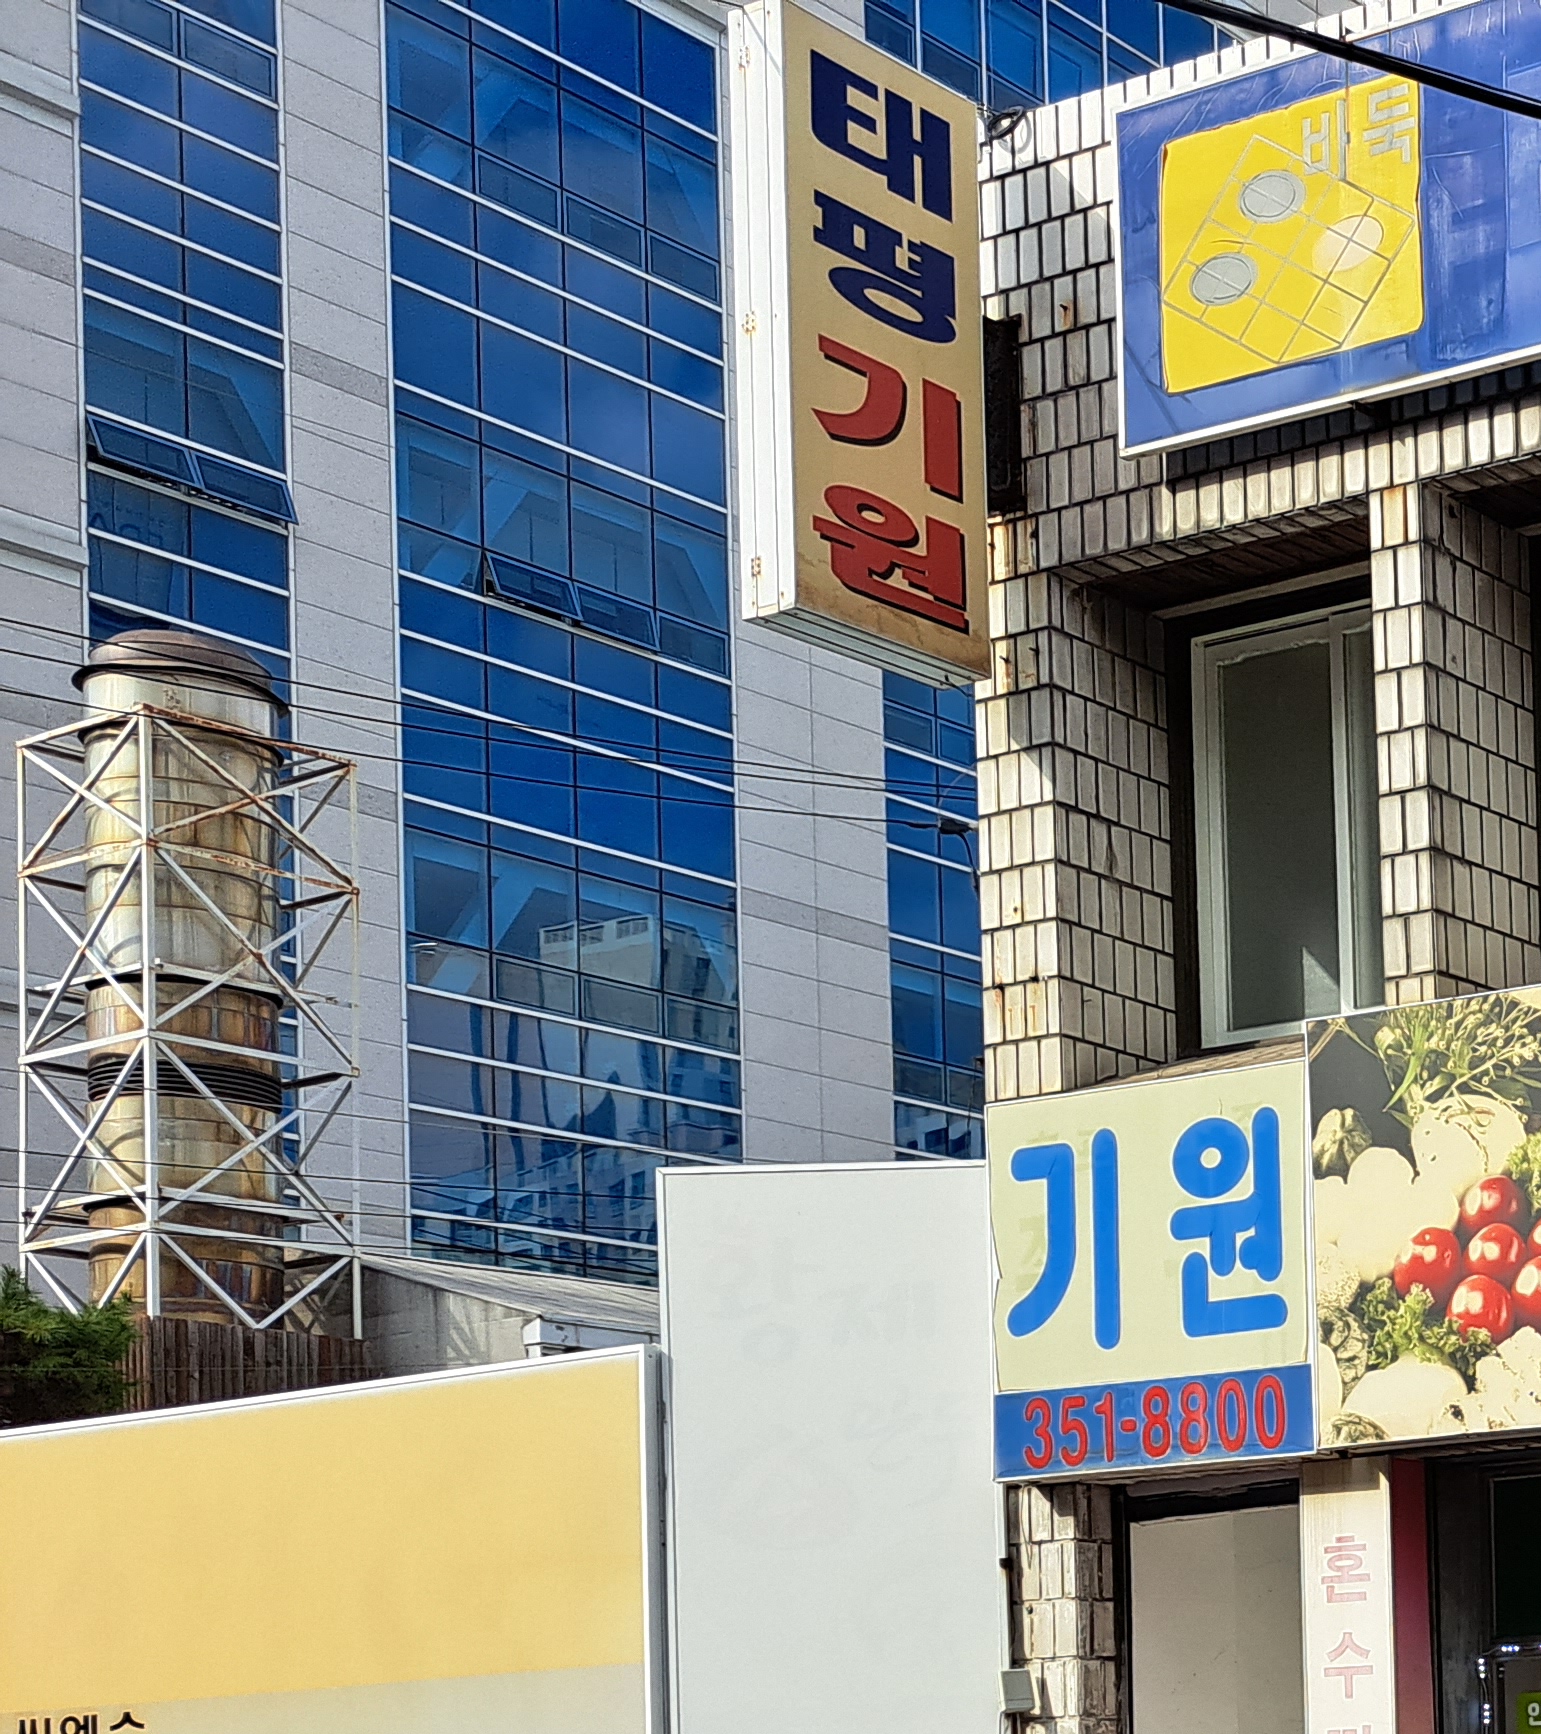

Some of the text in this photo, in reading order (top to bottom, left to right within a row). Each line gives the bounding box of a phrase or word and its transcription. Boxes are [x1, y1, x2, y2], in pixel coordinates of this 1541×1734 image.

[1302, 83, 1415, 177] 바둑
[811, 47, 970, 636] 태평기원
[1006, 1105, 1290, 1351] 기원
[1023, 1374, 1287, 1471] 351-8800
